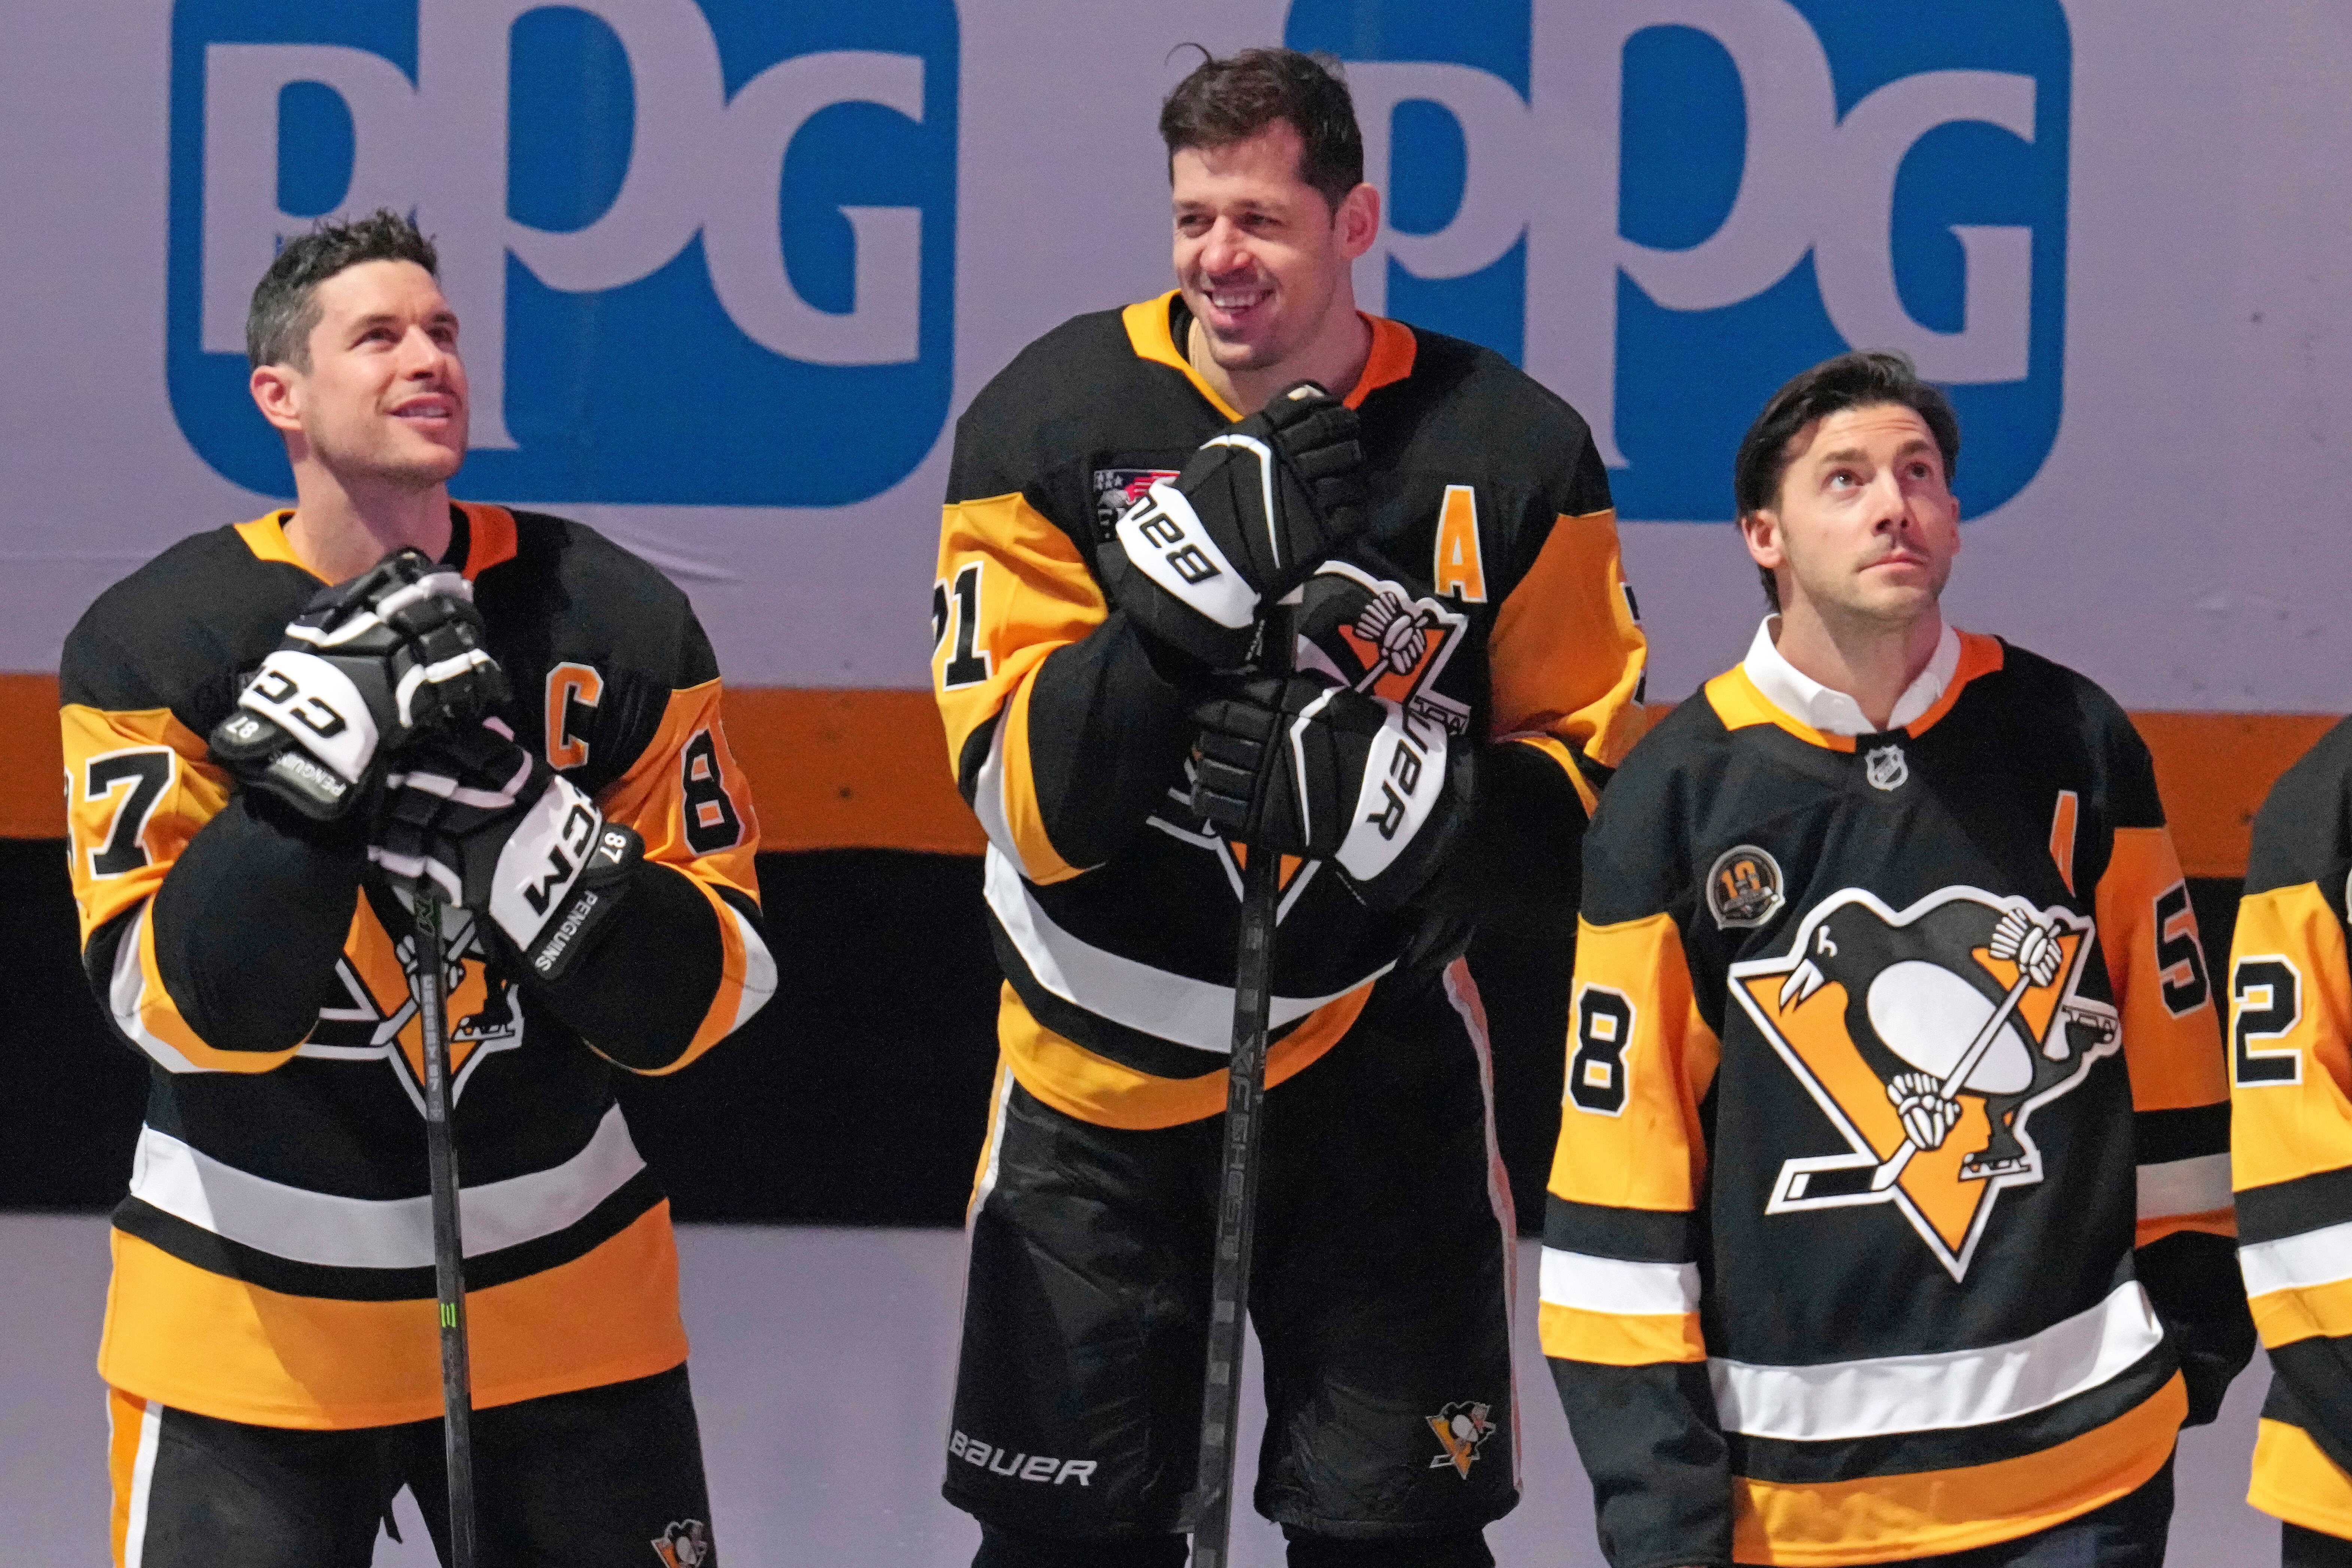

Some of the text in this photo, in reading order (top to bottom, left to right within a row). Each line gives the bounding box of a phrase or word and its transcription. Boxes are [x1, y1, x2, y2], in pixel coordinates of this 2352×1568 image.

[201, 0, 925, 450] PPG
[1345, 0, 2037, 469] PPG
[1434, 484, 1487, 604] A
[226, 716, 259, 738] 87
[252, 667, 348, 738] CC
[545, 661, 604, 771] C
[64, 744, 175, 880] 7
[524, 786, 598, 917] CM
[600, 832, 627, 864] 87
[680, 727, 746, 858] 8
[534, 890, 598, 971] PENGUINS
[2153, 877, 2211, 1019] 5
[1569, 981, 1636, 1118] 8
[2233, 953, 2303, 1089] 2
[949, 1429, 1098, 1486] BAUER
